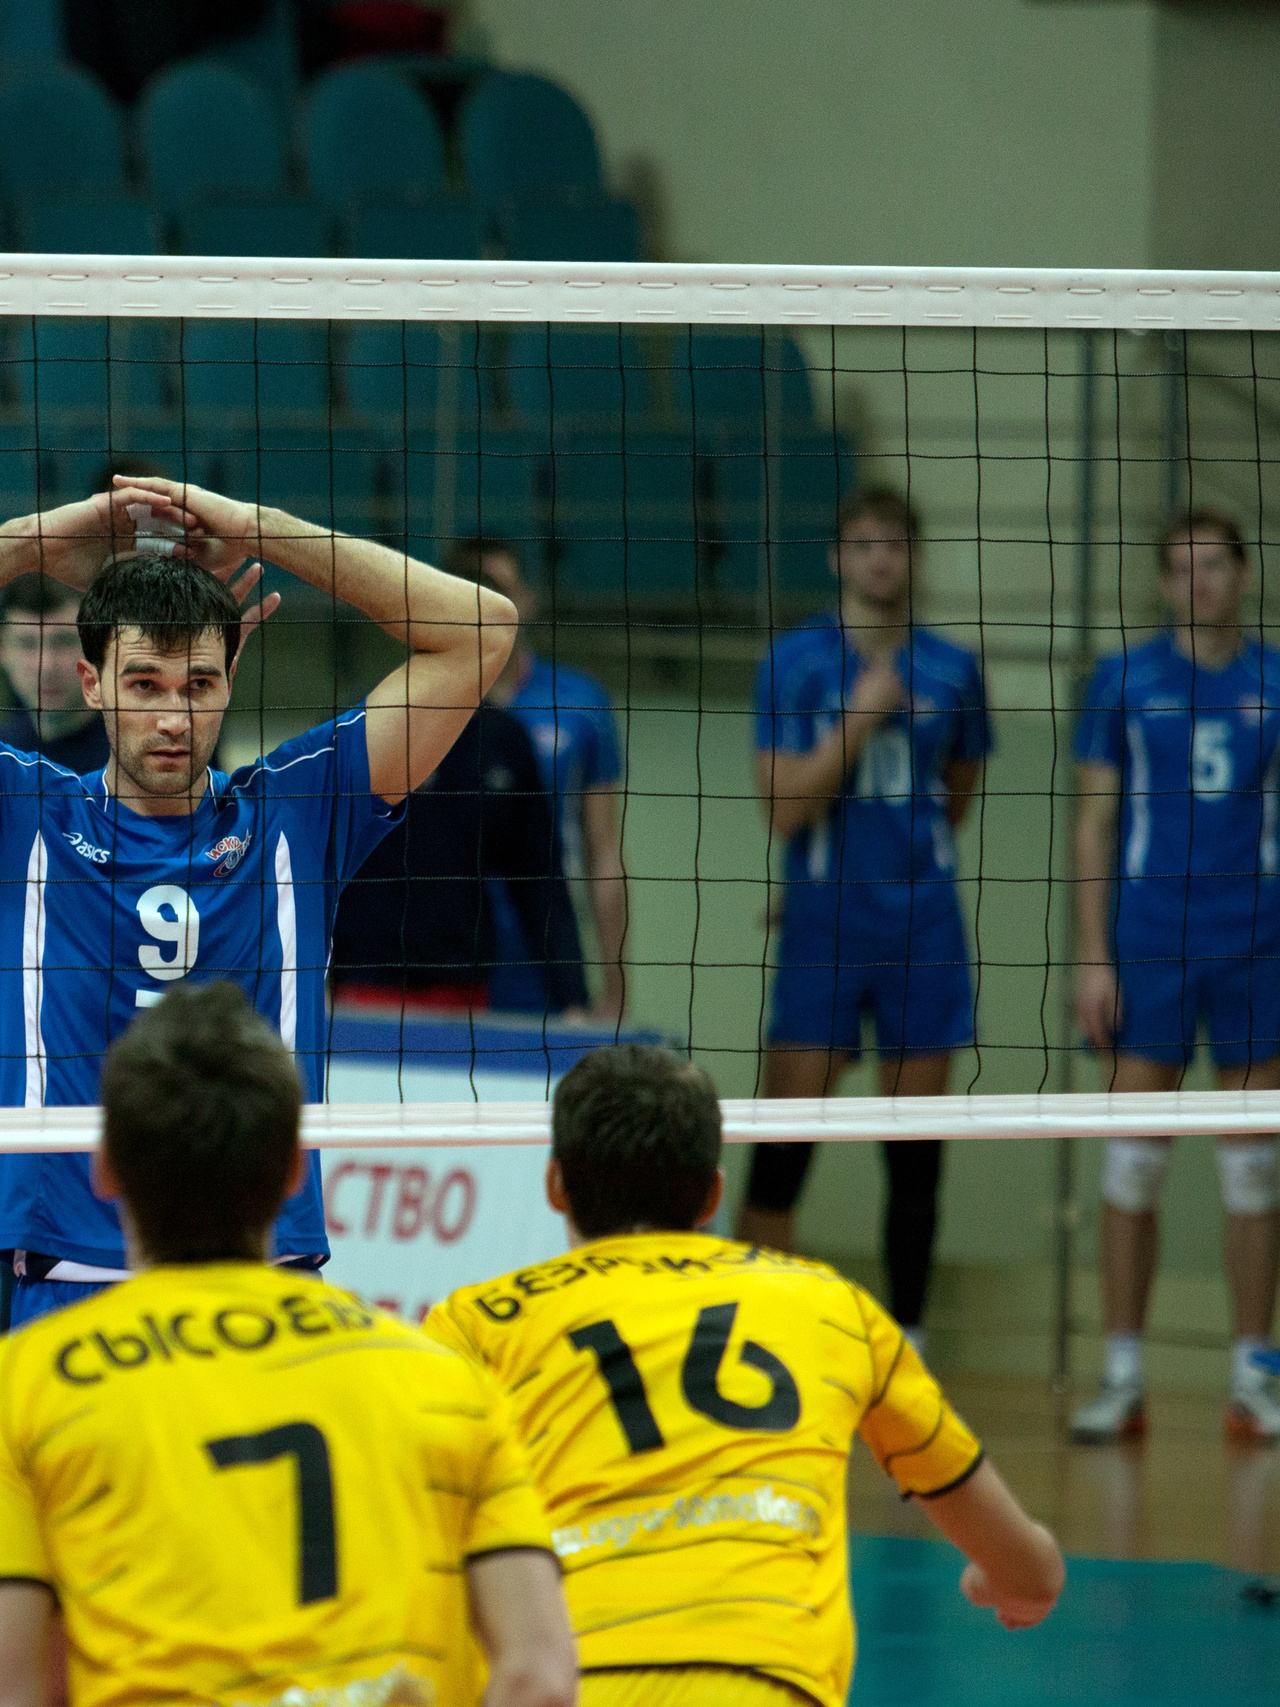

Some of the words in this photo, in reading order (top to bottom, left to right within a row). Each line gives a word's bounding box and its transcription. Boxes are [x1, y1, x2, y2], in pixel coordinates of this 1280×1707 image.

[1190, 719, 1233, 802] 5
[136, 884, 200, 981] 9
[568, 1302, 802, 1455] 16
[206, 1422, 341, 1607] 7
